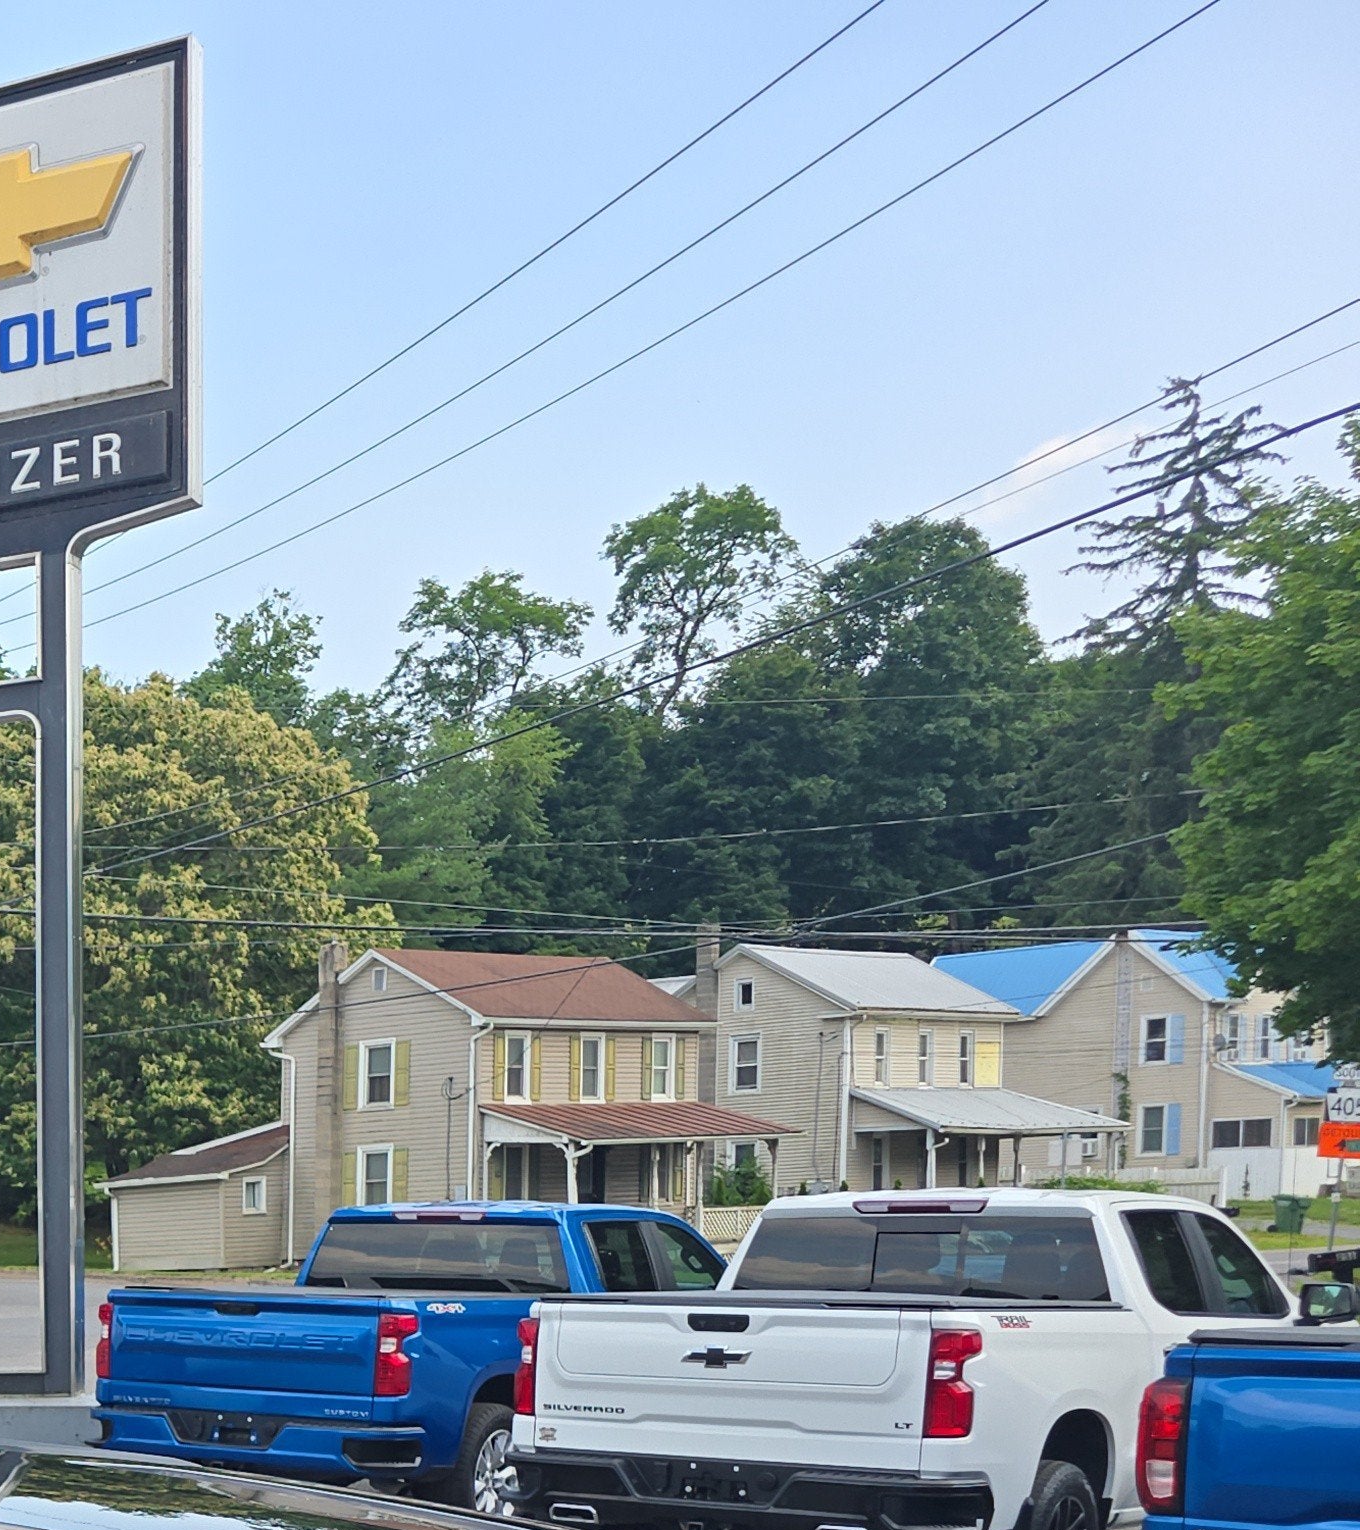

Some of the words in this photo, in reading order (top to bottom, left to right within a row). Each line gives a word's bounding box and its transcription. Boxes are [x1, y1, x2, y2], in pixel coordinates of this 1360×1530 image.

[125, 1328, 356, 1351] CHEVROLET
[542, 1403, 626, 1414] SILVERADO
[894, 1422, 914, 1430] LT
